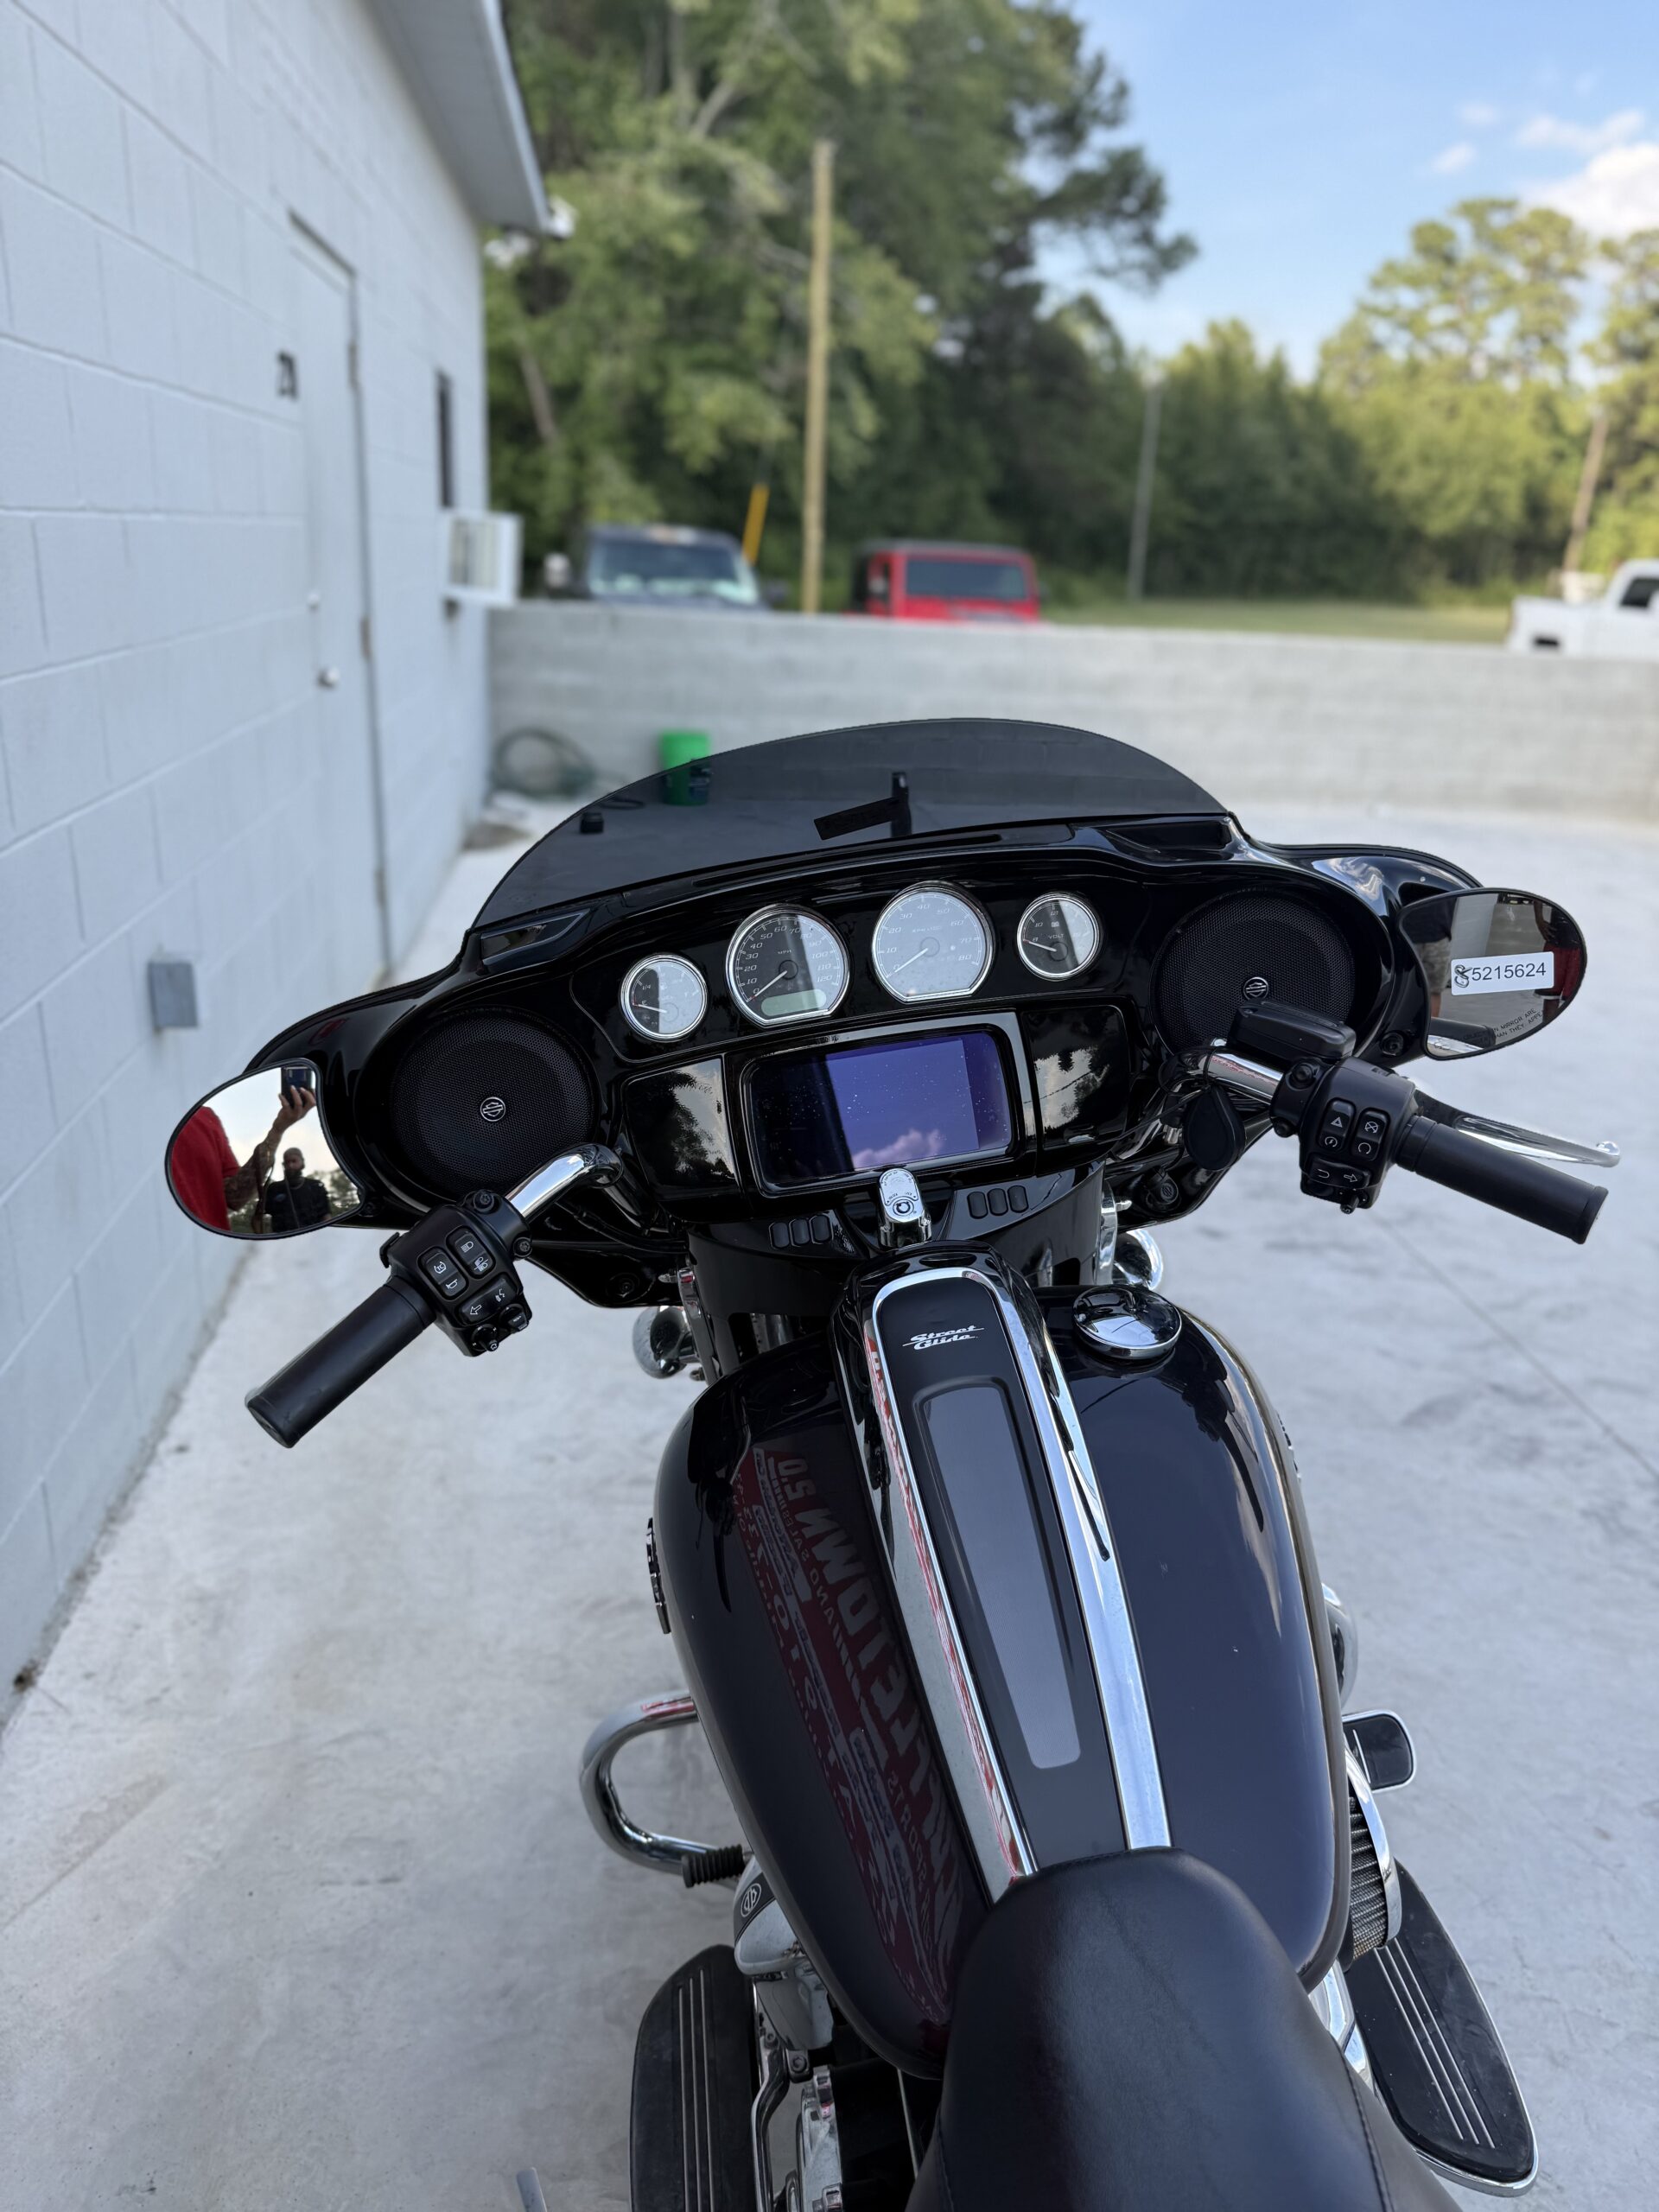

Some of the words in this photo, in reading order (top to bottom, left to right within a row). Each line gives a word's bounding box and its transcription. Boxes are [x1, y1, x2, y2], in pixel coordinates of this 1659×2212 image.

[760, 931, 772, 940] 50
[812, 950, 830, 959] 100
[747, 976, 758, 985] 10
[1500, 1016, 1522, 1029] MIRROR
[1524, 1008, 1537, 1018] ARE
[1509, 1023, 1524, 1033] THEY
[1528, 1012, 1541, 1024] APPE
[905, 1325, 983, 1344] Street
[913, 1334, 976, 1351] Glide
